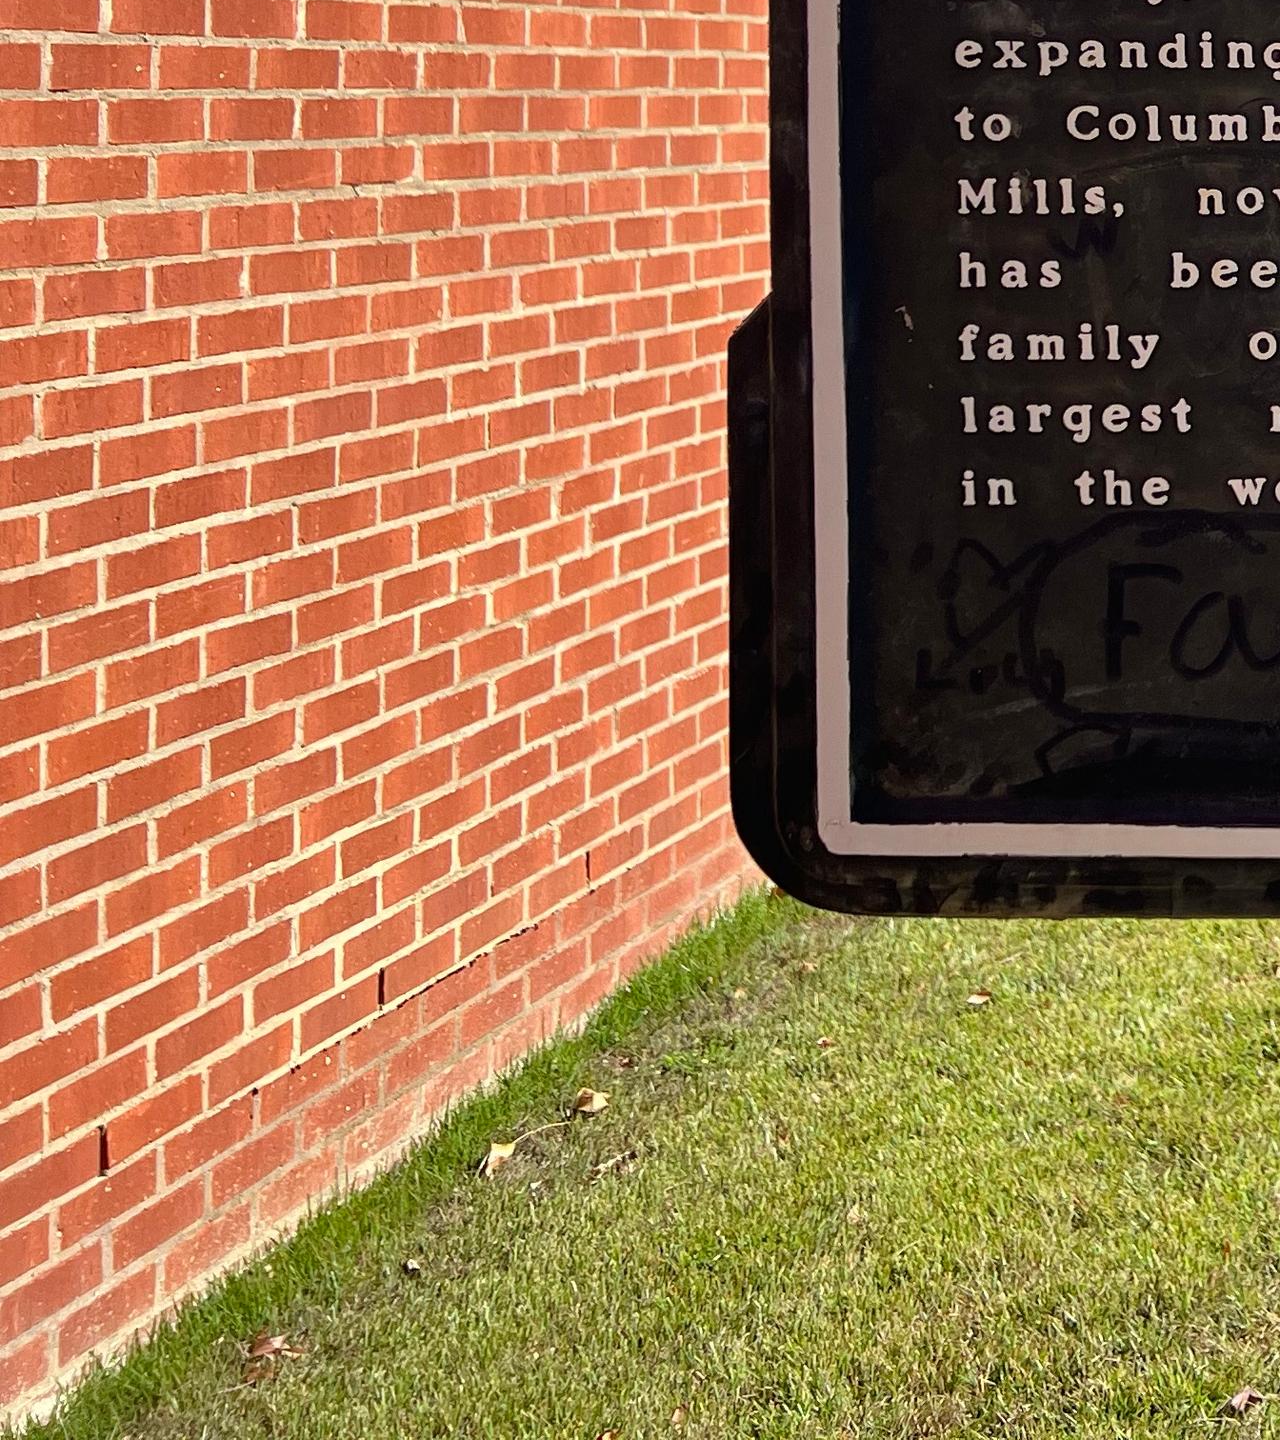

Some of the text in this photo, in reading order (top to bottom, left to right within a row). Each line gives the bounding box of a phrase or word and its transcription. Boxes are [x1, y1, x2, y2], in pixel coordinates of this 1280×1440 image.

[954, 106, 1012, 142] to
[957, 177, 1124, 218] Mills,
[959, 251, 1062, 288] has
[958, 322, 1160, 369] family
[960, 396, 1192, 443] largest
[961, 470, 1017, 506] in
[1074, 469, 1170, 506] the
